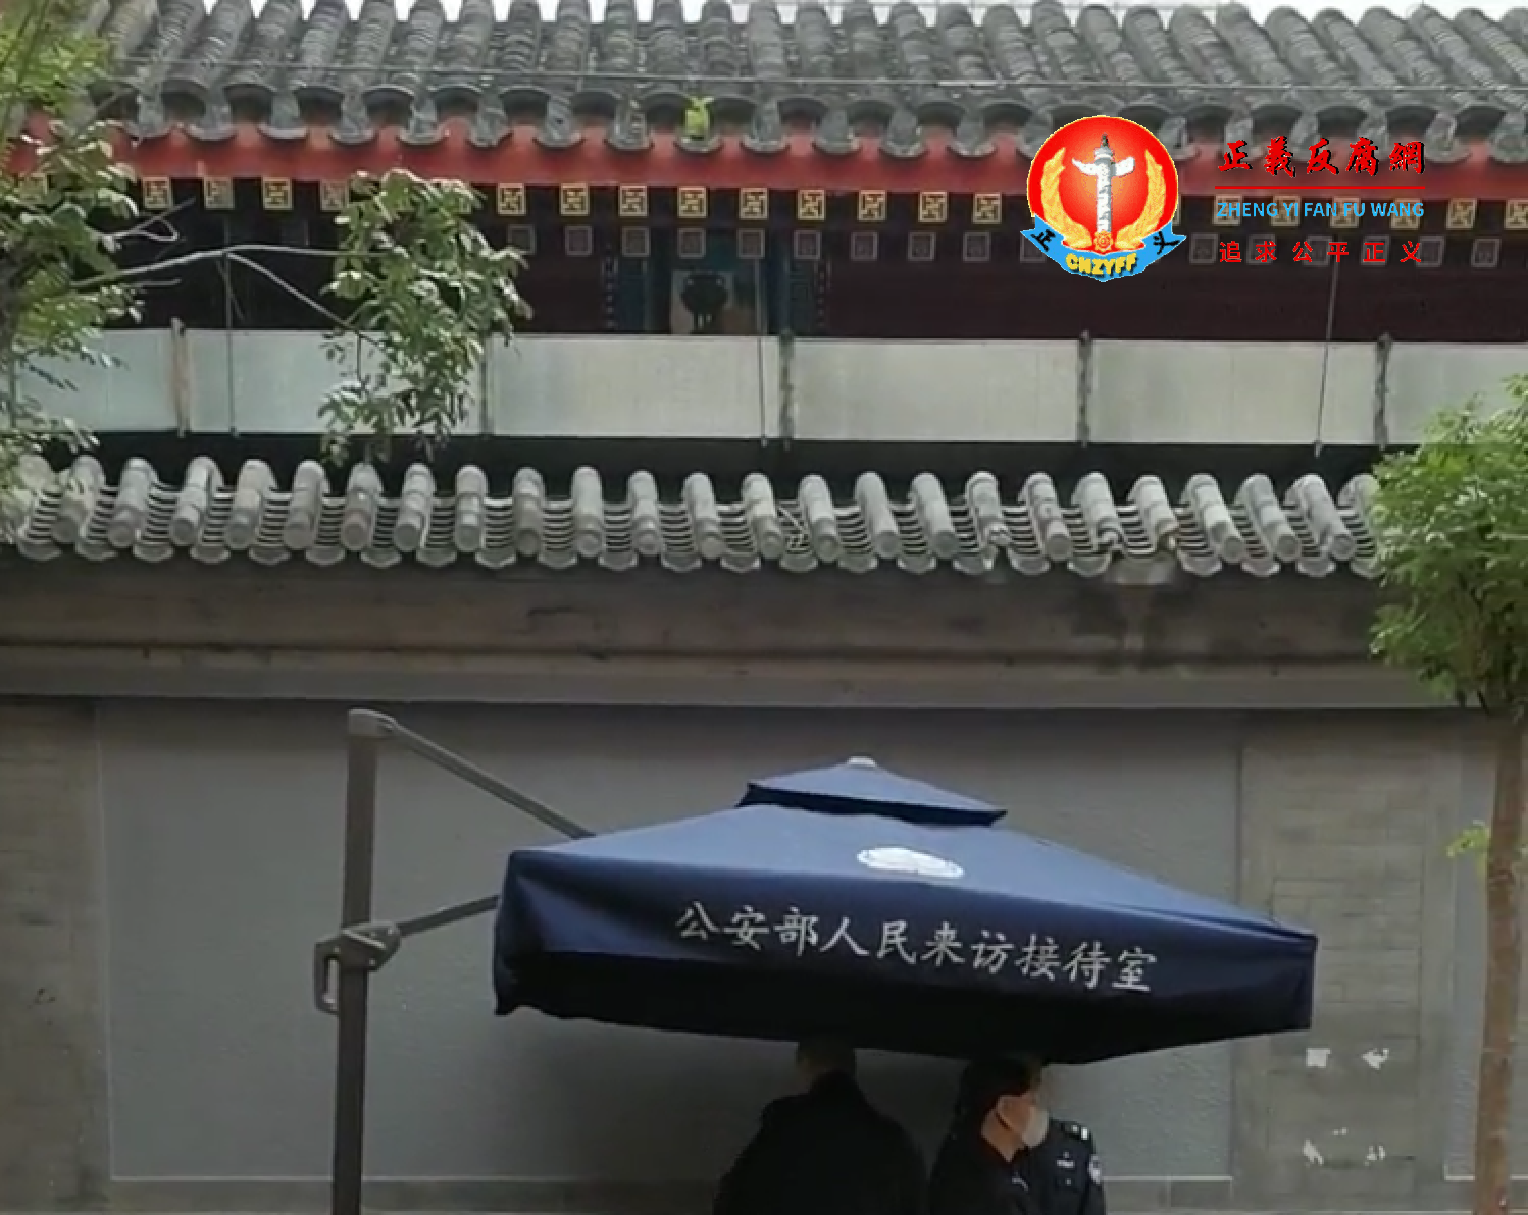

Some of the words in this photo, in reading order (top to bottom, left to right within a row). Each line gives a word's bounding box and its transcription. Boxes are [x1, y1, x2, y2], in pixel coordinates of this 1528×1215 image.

[675, 901, 1158, 992] 公安部人民来访接待室
